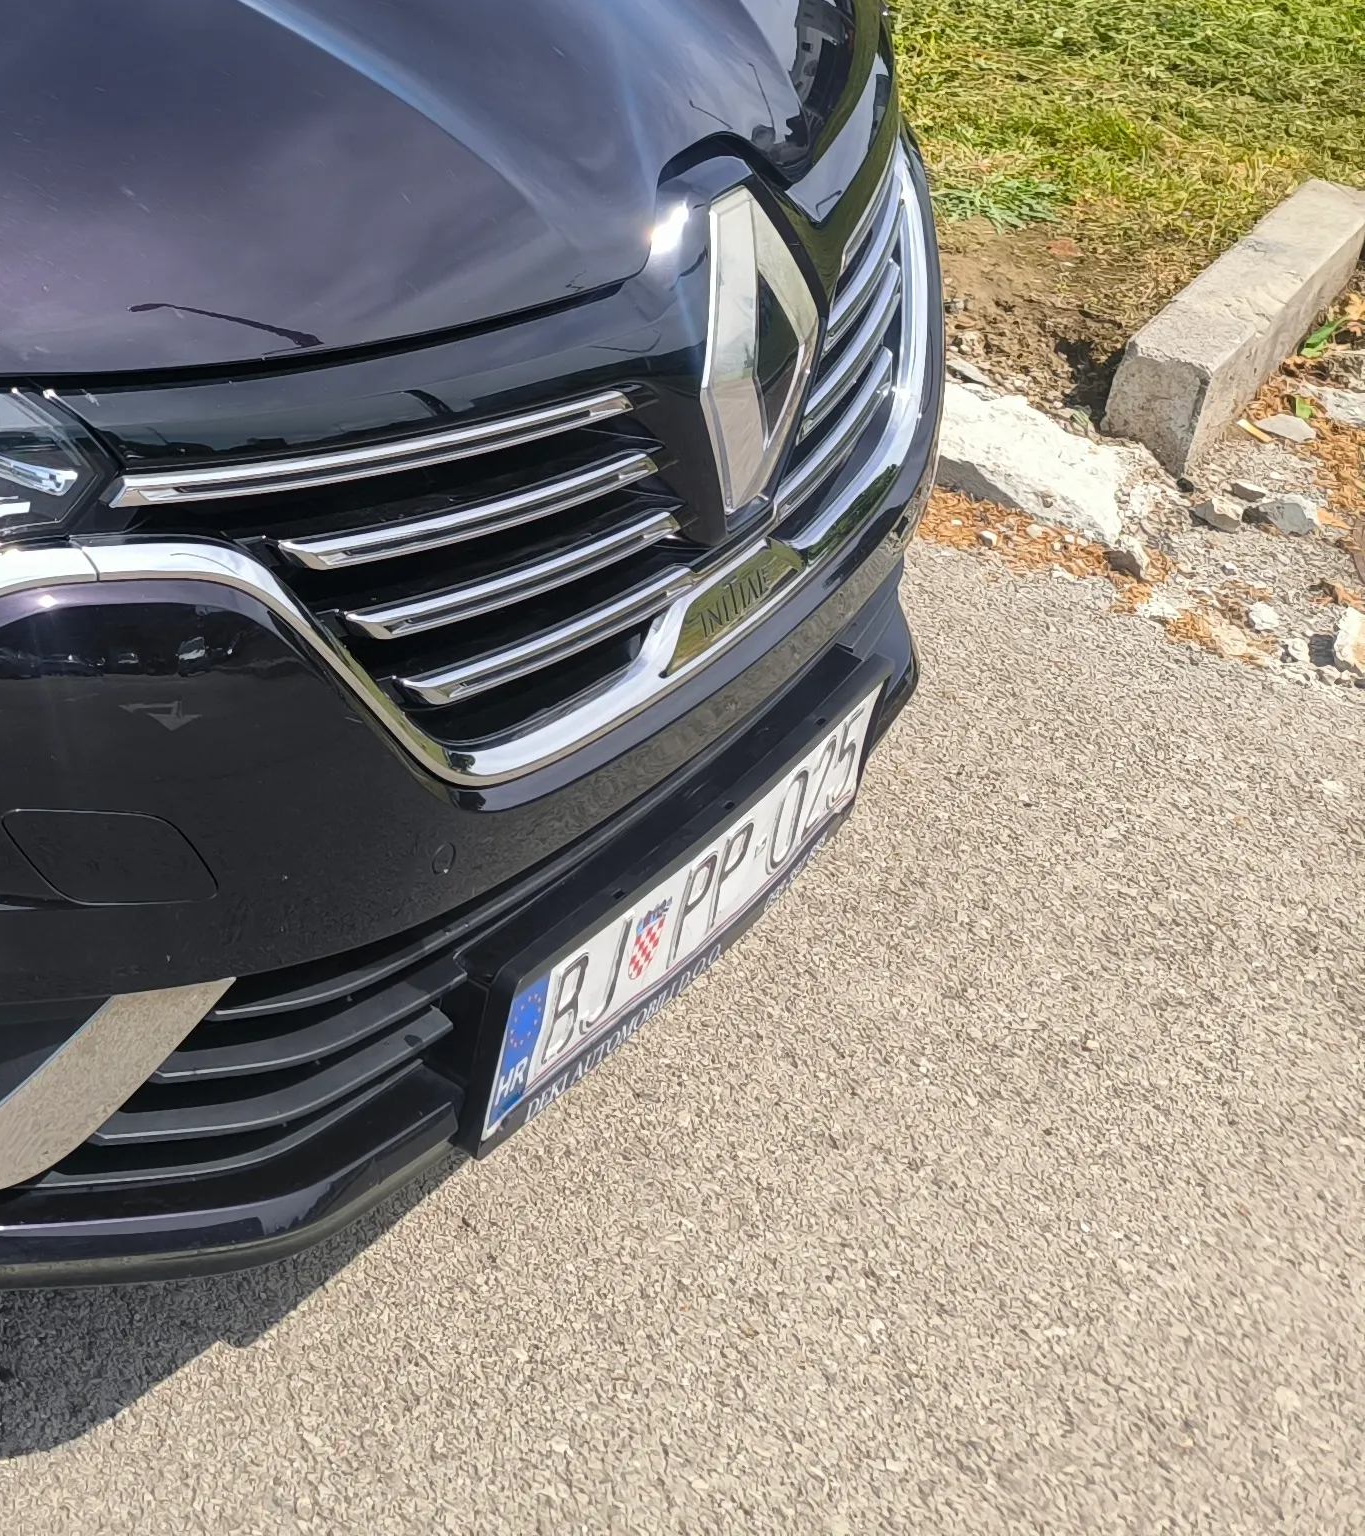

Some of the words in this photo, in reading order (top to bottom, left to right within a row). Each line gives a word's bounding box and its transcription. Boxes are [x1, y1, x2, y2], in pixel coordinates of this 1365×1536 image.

[540, 909, 636, 1065] BJ
[569, 978, 679, 1088] AUTOMOBILI
[494, 1056, 529, 1107] HR
